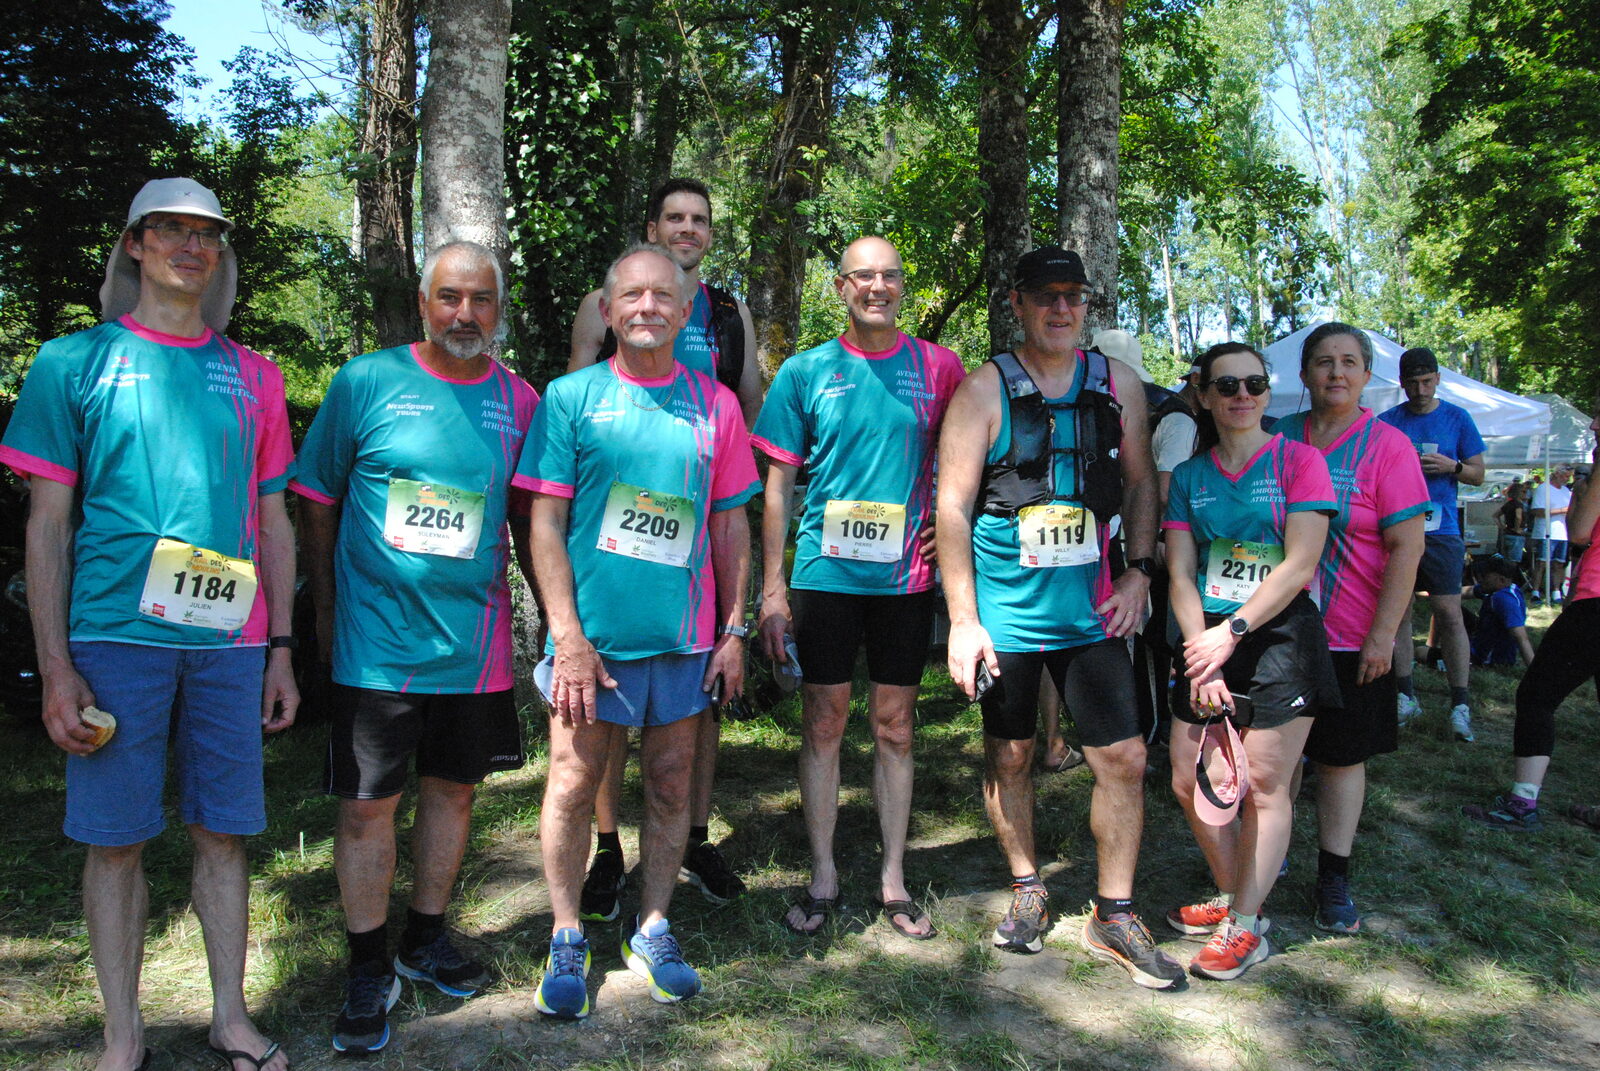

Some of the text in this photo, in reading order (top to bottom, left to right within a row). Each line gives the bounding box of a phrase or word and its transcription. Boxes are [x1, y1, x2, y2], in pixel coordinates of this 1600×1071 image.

[205, 361, 239, 375] AVENIR
[896, 369, 920, 379] AVENIR
[481, 399, 509, 412] AVENIR
[672, 399, 700, 410] AVENIR
[481, 410, 514, 425] AMBOISE
[1251, 479, 1278, 487] AVENIR
[405, 504, 465, 533] 2264
[619, 508, 680, 540] 2209
[840, 519, 890, 541] 1067
[1036, 525, 1085, 546] 1119
[636, 536, 657, 546] DANIEL
[1221, 558, 1272, 584] 2210
[173, 571, 237, 603] 1184
[189, 602, 212, 610] JULIEN
